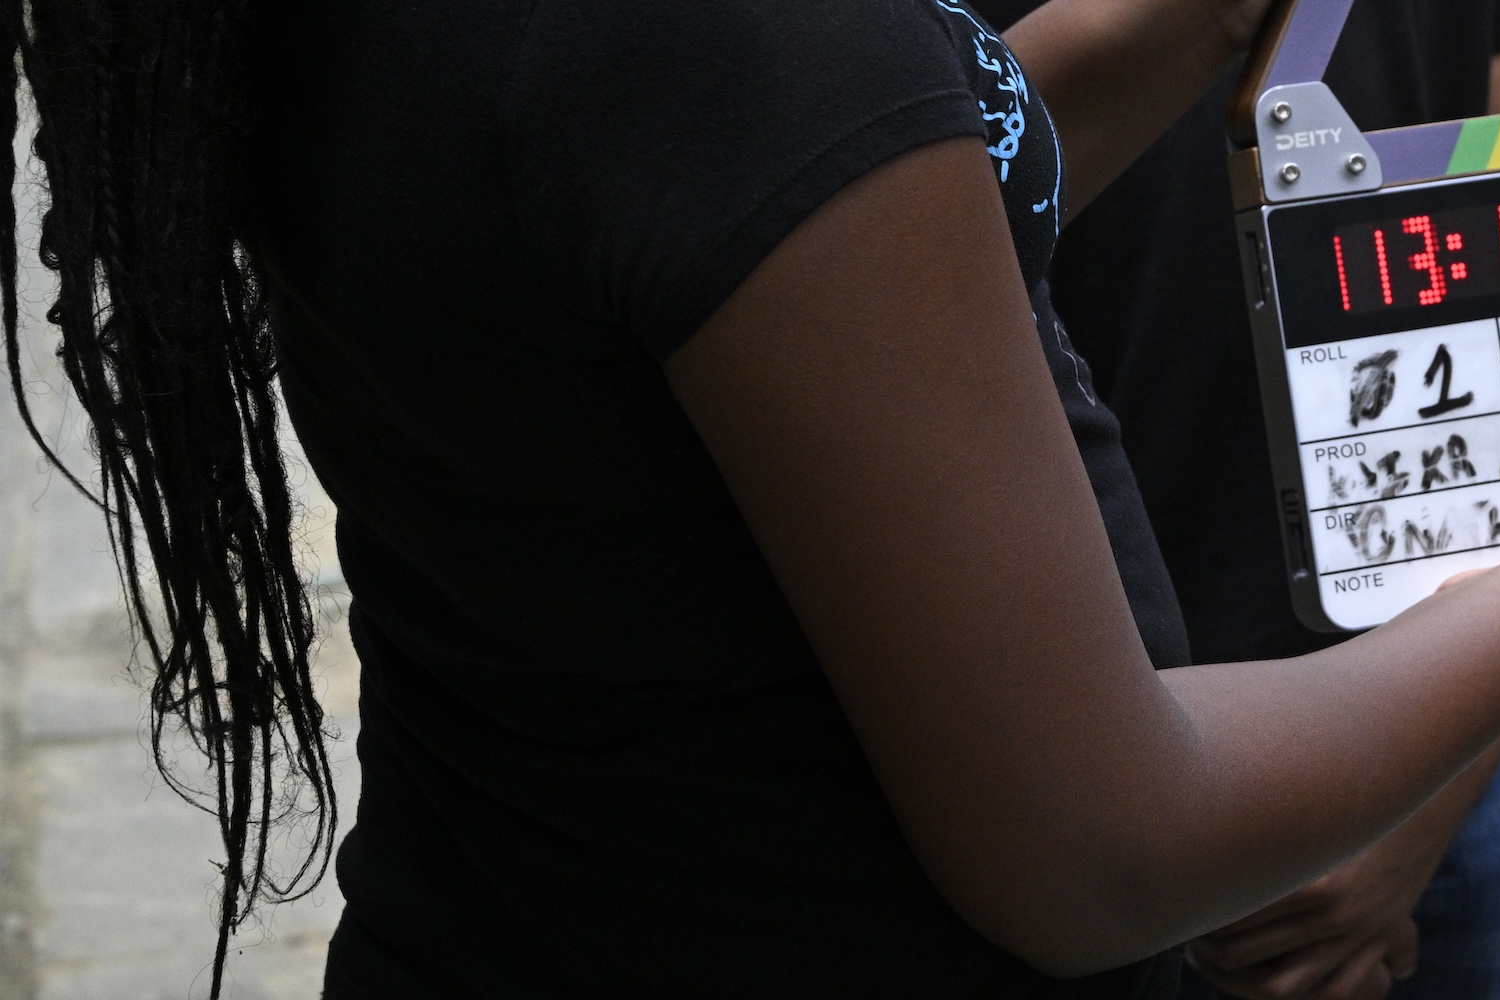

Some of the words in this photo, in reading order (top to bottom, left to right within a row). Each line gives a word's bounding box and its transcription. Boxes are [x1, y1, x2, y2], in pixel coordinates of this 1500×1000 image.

[1276, 126, 1342, 151] DEITY
[1300, 346, 1347, 364] ROLL
[1315, 441, 1366, 462] PROD
[1325, 512, 1357, 530] DIR
[1335, 573, 1384, 594] NOTE
